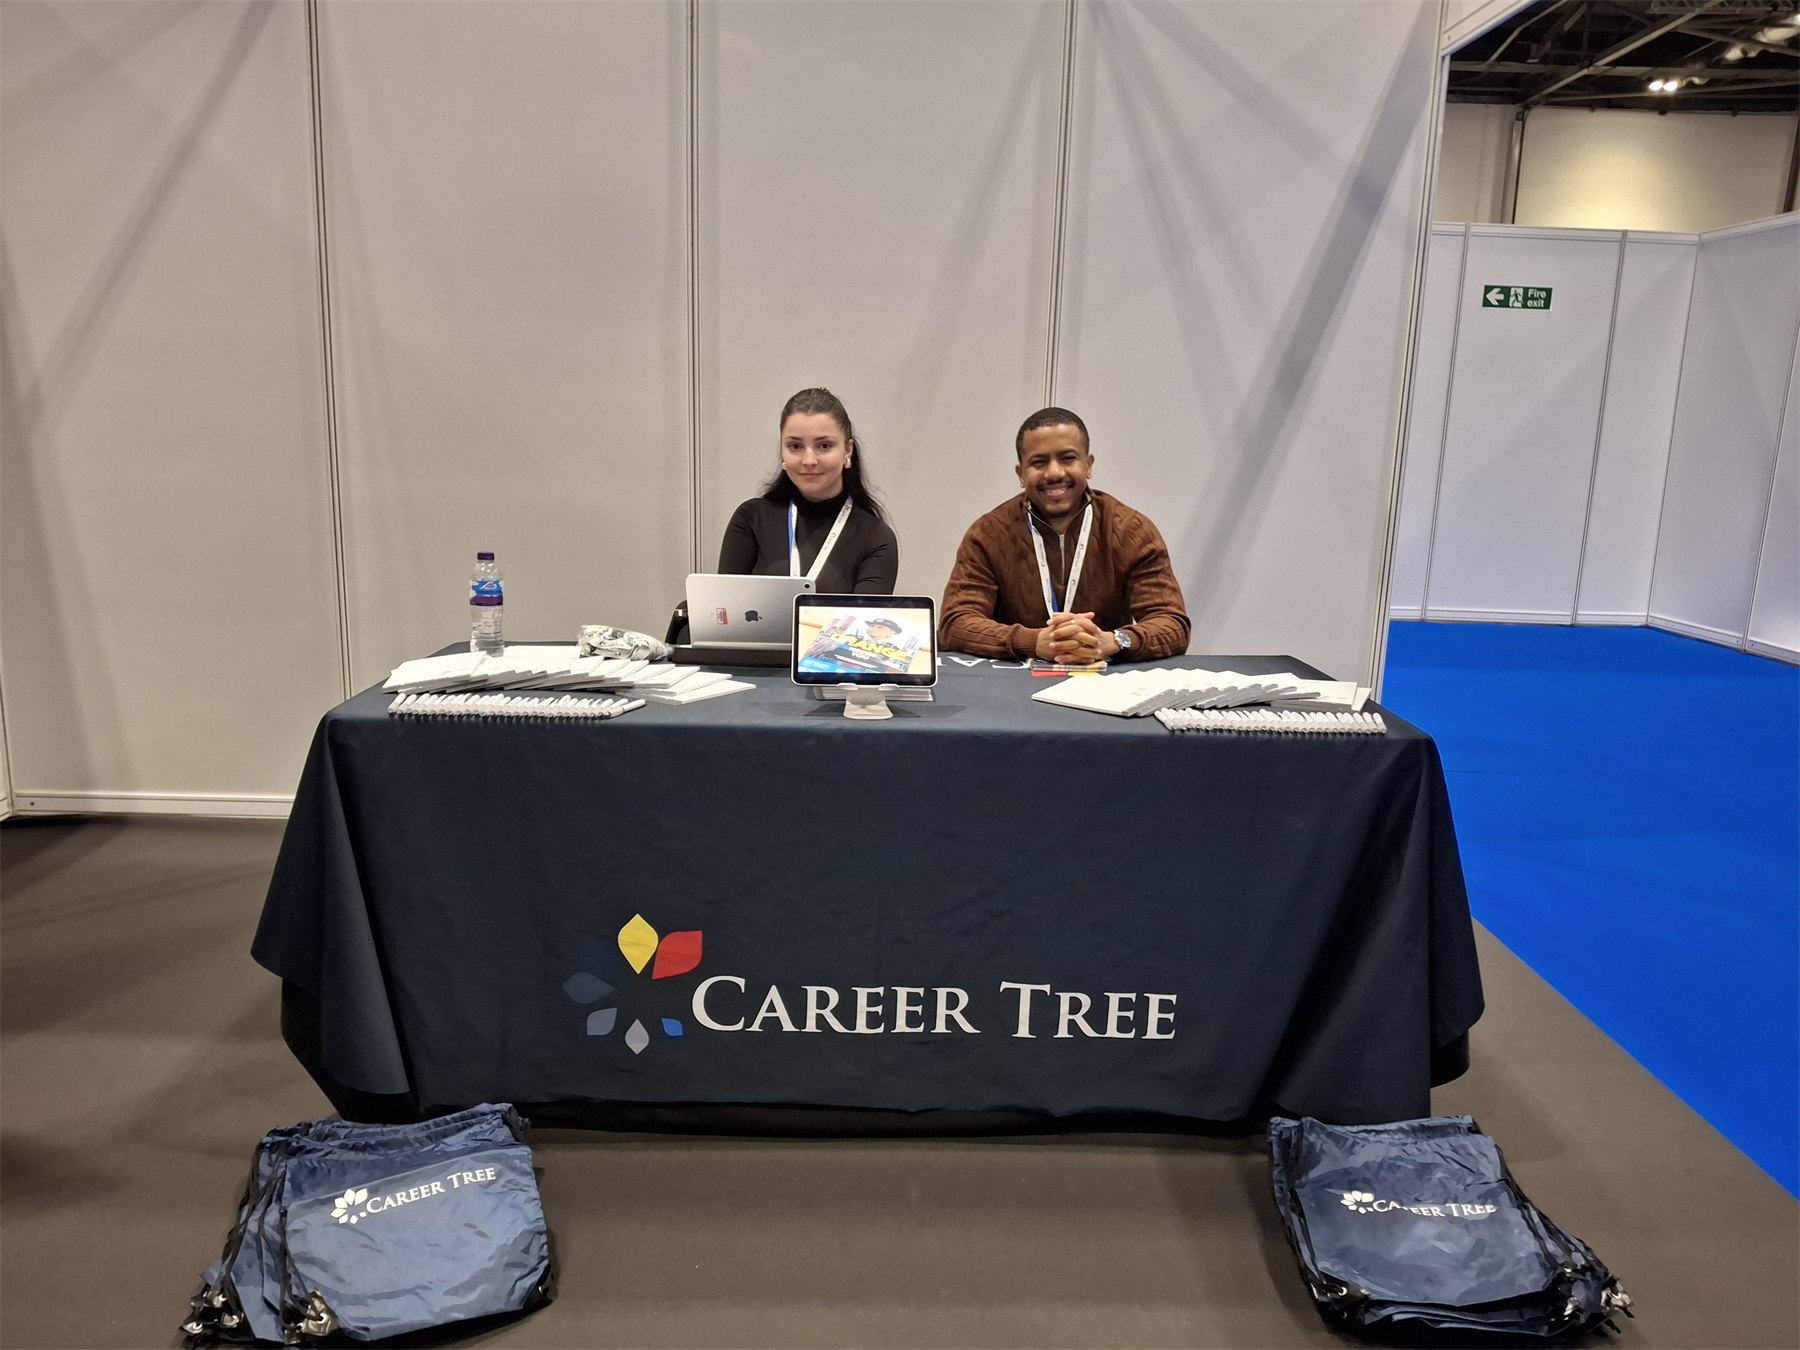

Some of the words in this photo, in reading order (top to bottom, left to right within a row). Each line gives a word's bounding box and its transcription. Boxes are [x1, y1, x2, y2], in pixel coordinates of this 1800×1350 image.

[1528, 288, 1547, 299] Fire
[1526, 299, 1545, 308] exit
[692, 975, 981, 1034] CAREER
[1000, 981, 1177, 1040] TREE
[366, 1181, 446, 1214] CAREER
[447, 1167, 496, 1189] TREE
[1445, 1203, 1498, 1217] TREE
